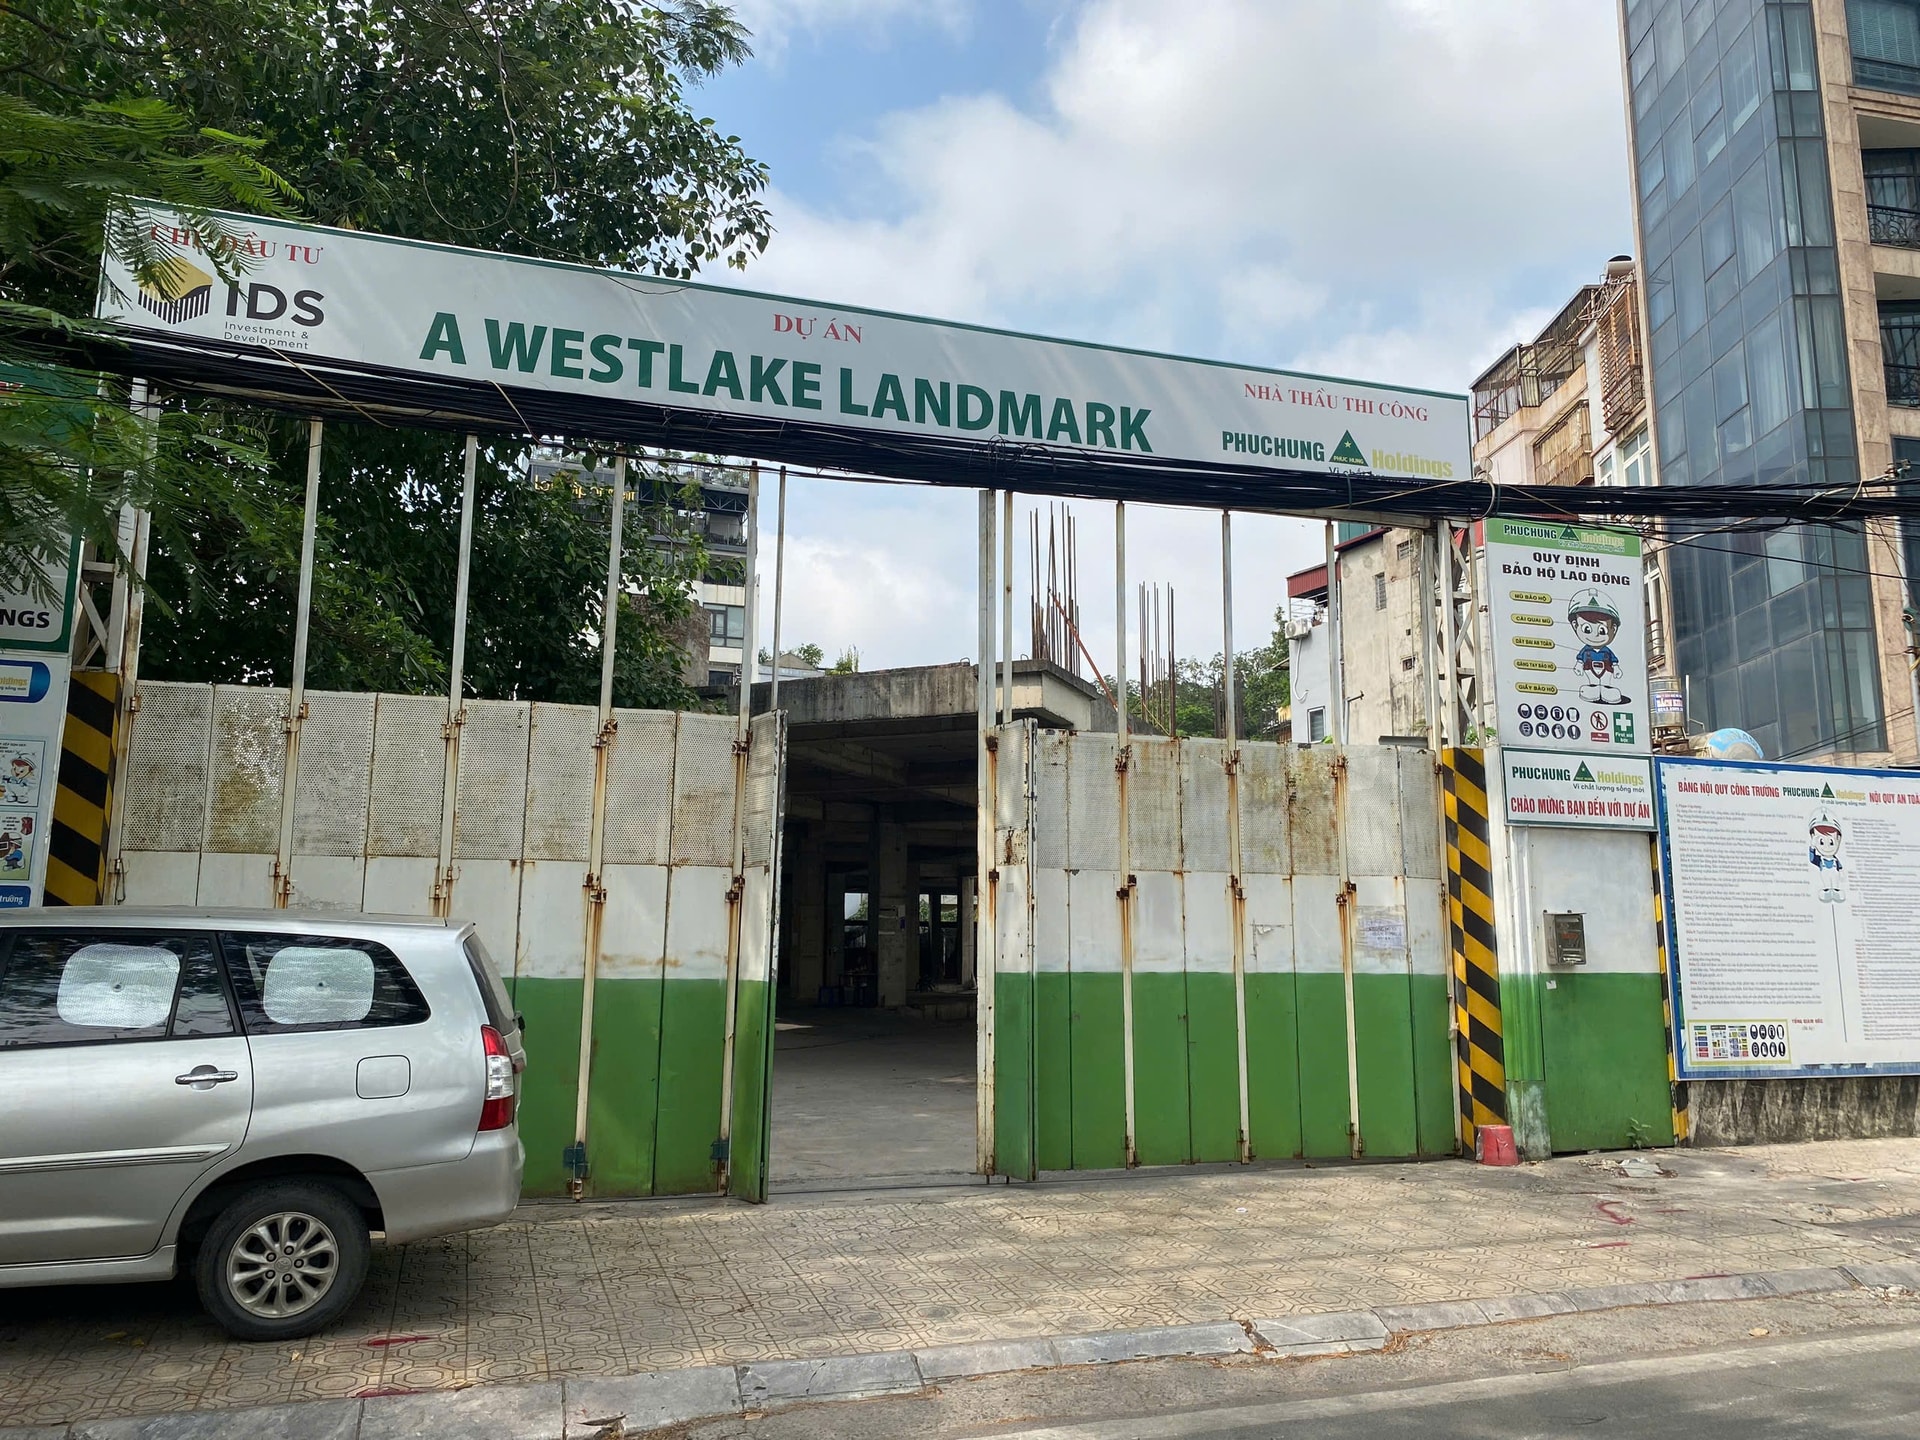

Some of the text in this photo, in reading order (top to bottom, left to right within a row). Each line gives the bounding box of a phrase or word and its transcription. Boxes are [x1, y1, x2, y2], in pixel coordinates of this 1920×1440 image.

[285, 244, 324, 265] TƯ
[226, 281, 324, 327] IDS
[225, 321, 309, 340] Investment &
[773, 313, 863, 344] DỰ ÁN
[224, 331, 308, 349] Development
[419, 312, 1153, 453] A WESTLAKE LANDMARK
[1244, 383, 1428, 422] NHÀ THẦU THI CÔNG
[1222, 430, 1453, 478] PHUCHUNG Holdings
[1504, 524, 1557, 539] PHUCHUNG
[1533, 552, 1600, 568] QUY ĐỊNH
[1502, 561, 1631, 586] BẢO HỘ LAO ĐỘNG
[0, 608, 50, 628] NGS
[1512, 766, 1644, 786] PHUCHUNG Holdings
[1678, 777, 1780, 798] BẢNG NỘI QUY CÔNG TRƯỜNG
[1782, 786, 1820, 798] PHUCHUNG
[1869, 790, 1881, 805] NỘI
[1882, 793, 1895, 804] QUY
[1897, 793, 1906, 804] AN
[1510, 794, 1650, 821] CHÀO MỪNG BẠN ĐẾN VỚI DỰ ÁN
